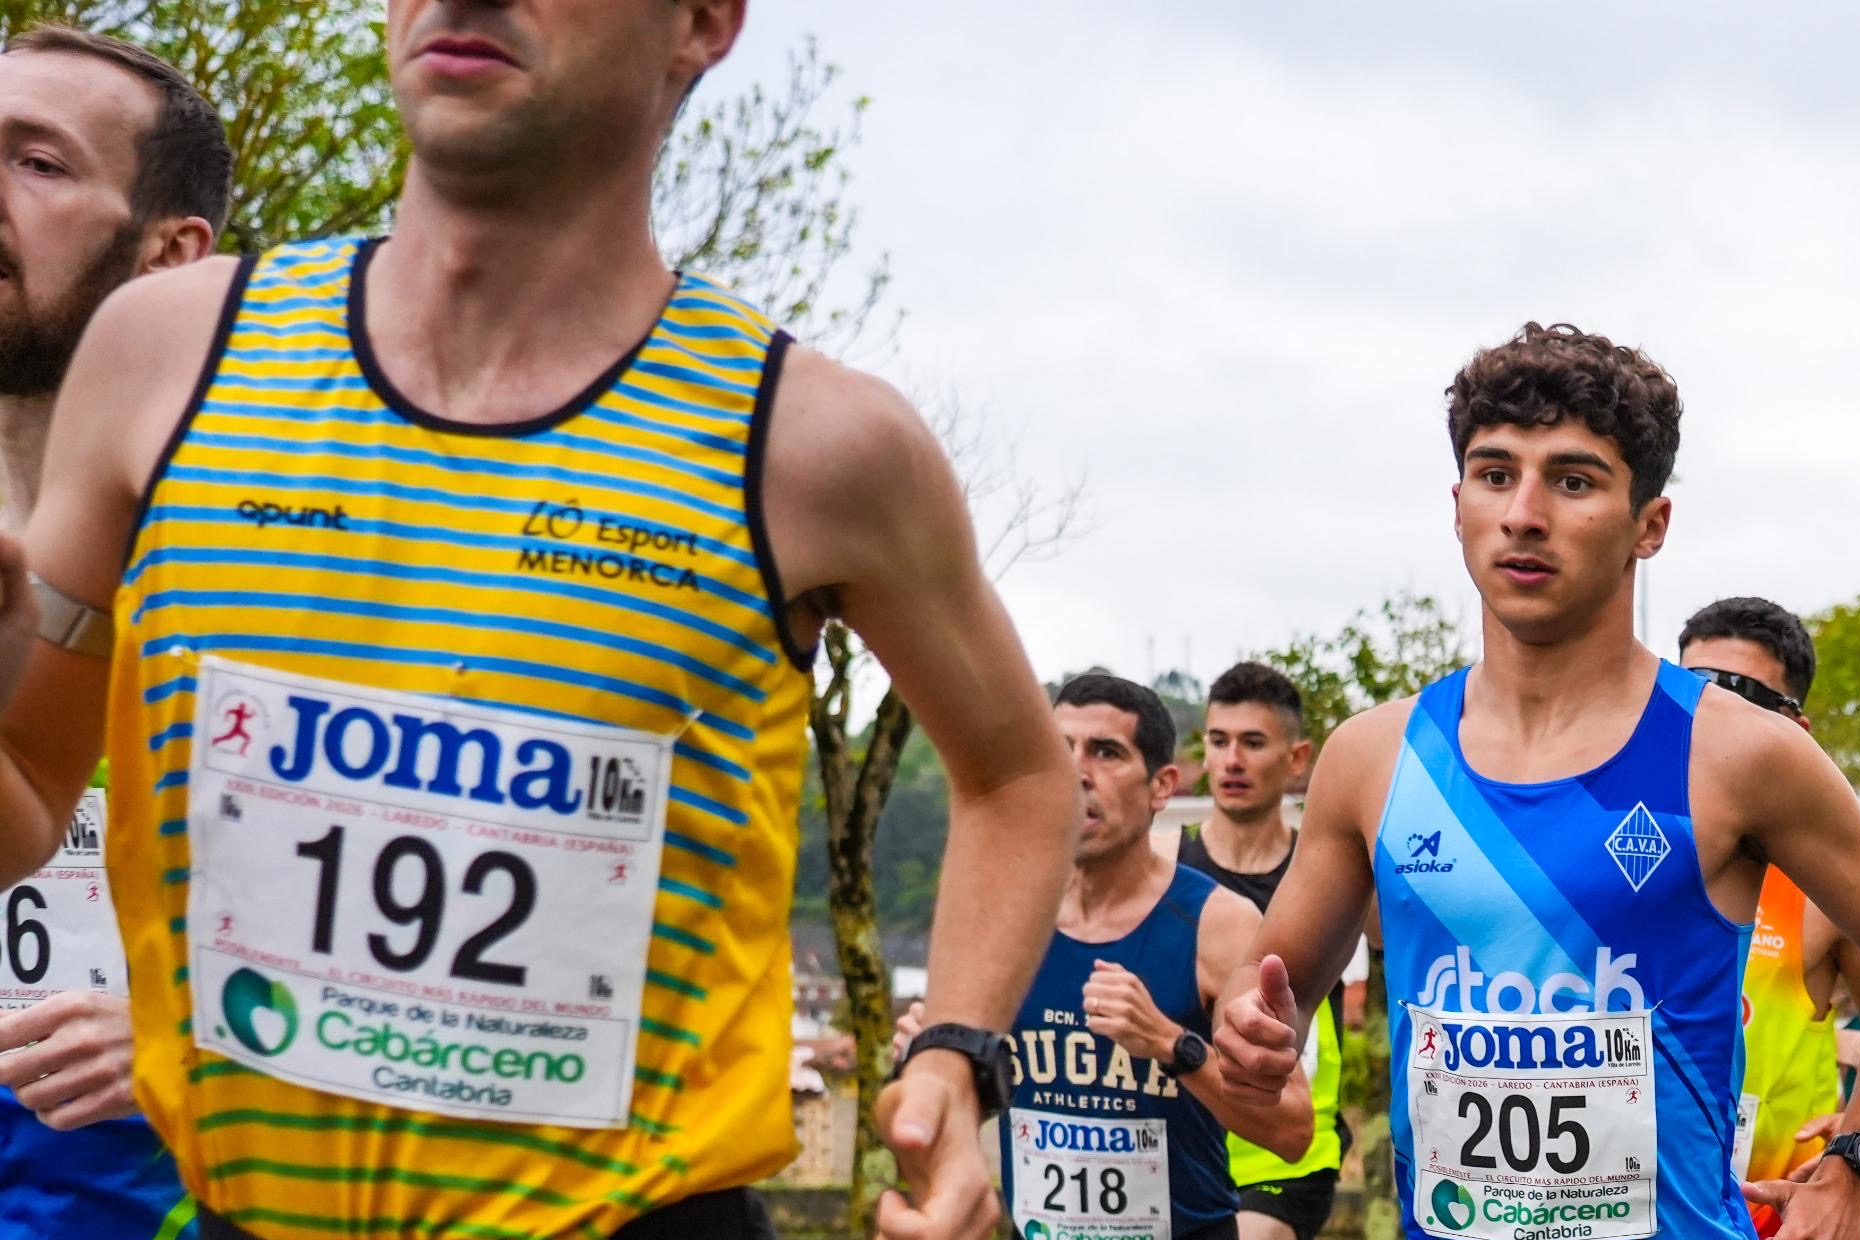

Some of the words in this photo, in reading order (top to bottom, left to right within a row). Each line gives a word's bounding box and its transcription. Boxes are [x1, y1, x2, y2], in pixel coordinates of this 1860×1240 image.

[597, 517, 699, 557] Esport
[516, 547, 701, 592] MENORCA
[1615, 837, 1661, 854] C.A.V.A.
[1394, 859, 1453, 874] asioka
[296, 825, 538, 987] 192
[5, 885, 50, 985] 6
[322, 986, 399, 1018] Parque
[406, 1005, 433, 1022] de
[441, 1009, 459, 1028] la
[466, 1013, 588, 1041] Naturaleza
[1044, 1008, 1079, 1026] BCN.
[316, 1010, 585, 1083] Cabárceno
[372, 1065, 513, 1105] Cantabria
[1468, 1080, 1488, 1089] 2026
[1498, 1081, 1533, 1090] LAREDO
[1543, 1081, 1595, 1090] CANTABRIA
[1598, 1077, 1639, 1089] (ESPAÑA)
[1033, 1091, 1137, 1112] ATHLETICS
[1458, 1091, 1590, 1174] 205
[1043, 1164, 1128, 1215] 218
[1484, 1185, 1525, 1199] Parque
[1528, 1189, 1542, 1200] de
[1546, 1190, 1556, 1200] la
[1560, 1185, 1629, 1199] Naturaleza
[1496, 1174, 1532, 1184] CIRCUITO
[1589, 1175, 1604, 1183] DEL
[1607, 1173, 1640, 1181] MUNDO
[1483, 1198, 1630, 1226] Cabárceno
[1513, 1223, 1592, 1240] Cantabria
